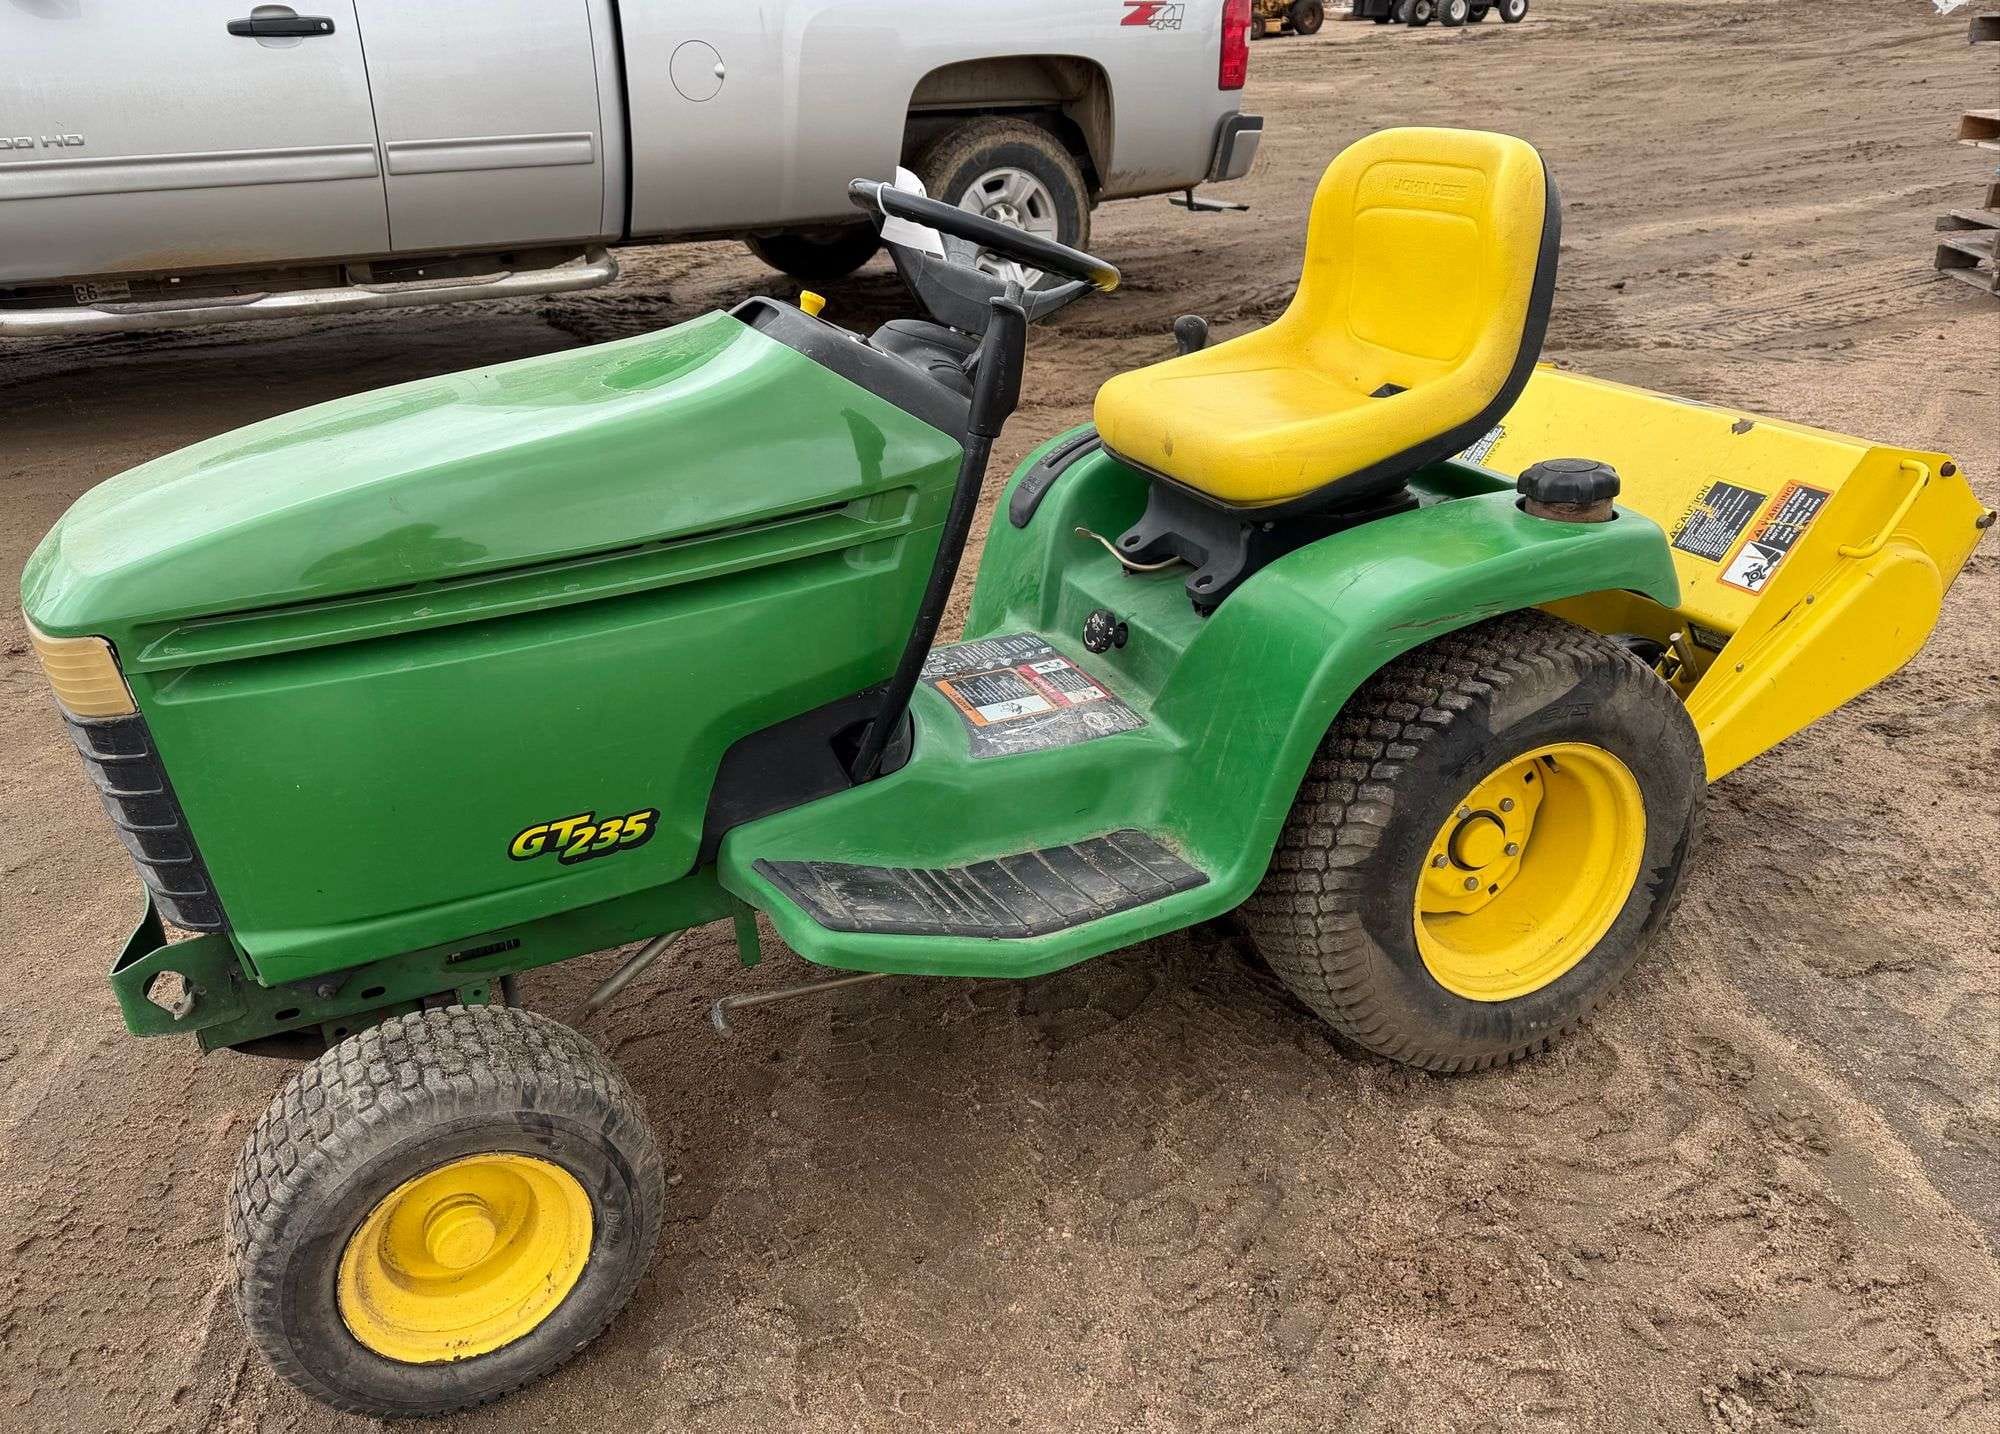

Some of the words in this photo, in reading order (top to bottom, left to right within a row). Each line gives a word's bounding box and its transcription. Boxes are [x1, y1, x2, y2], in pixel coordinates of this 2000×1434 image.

[40, 133, 85, 148] HD
[1675, 485, 1711, 530] CAUION
[510, 809, 656, 862] GT235
